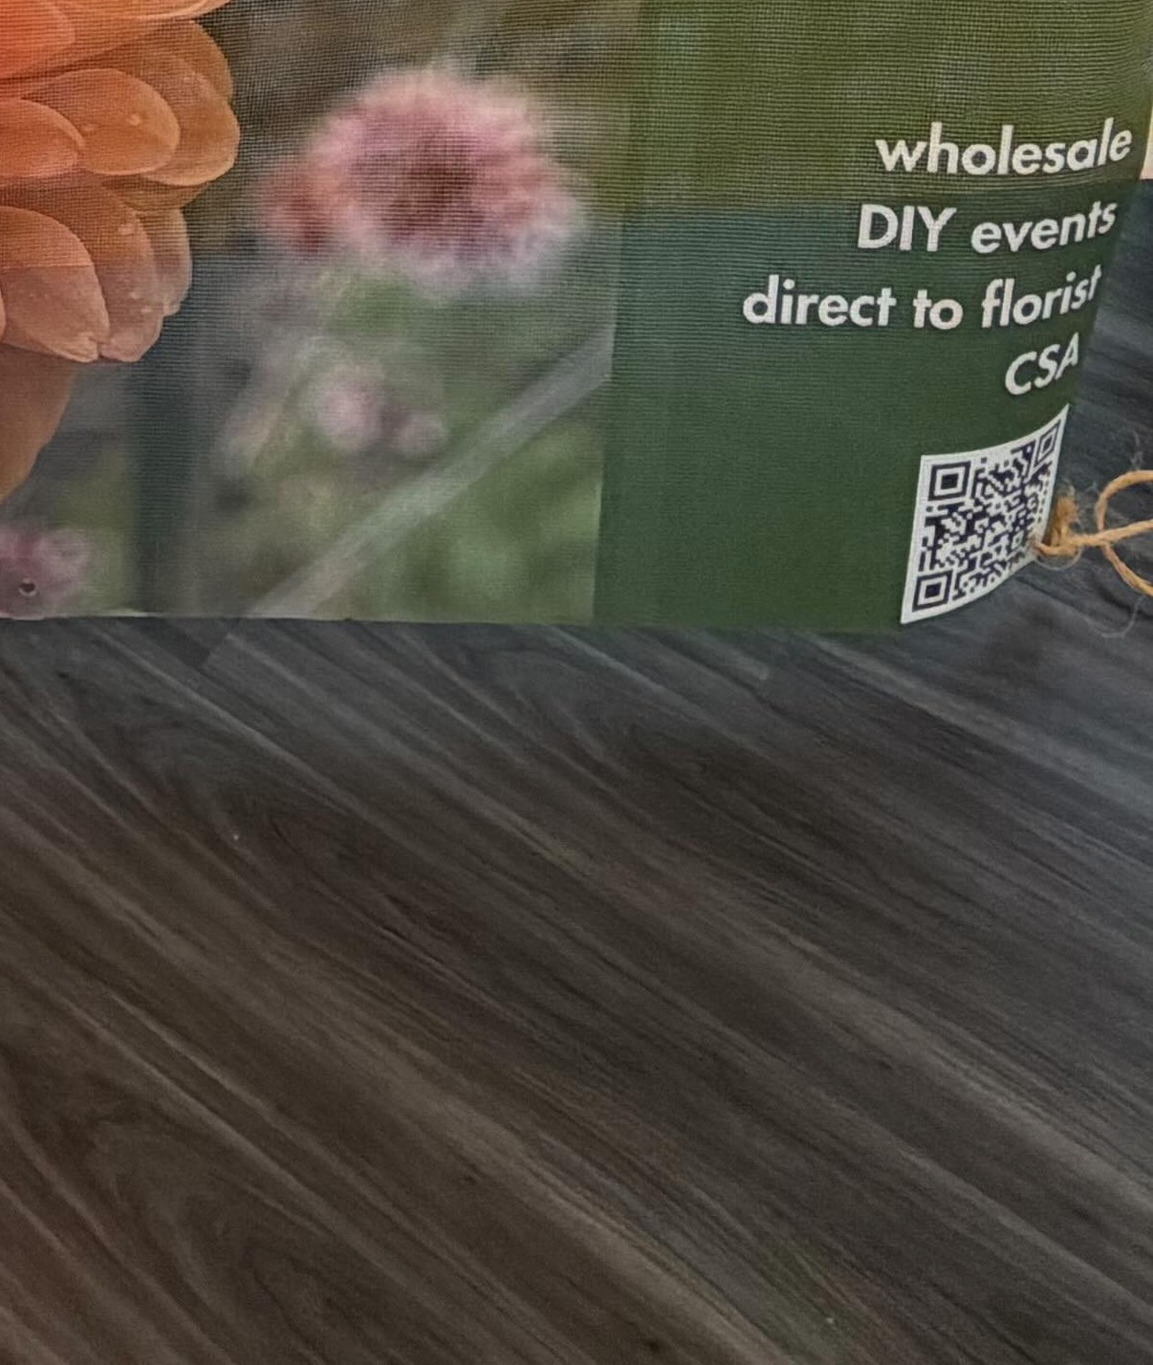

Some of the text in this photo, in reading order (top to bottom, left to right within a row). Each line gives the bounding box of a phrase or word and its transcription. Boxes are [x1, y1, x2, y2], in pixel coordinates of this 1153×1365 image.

[875, 117, 1133, 176] wholesale
[857, 200, 1118, 254] DIY events
[743, 264, 1103, 330] direct to florist
[1003, 331, 1081, 396] CSA
